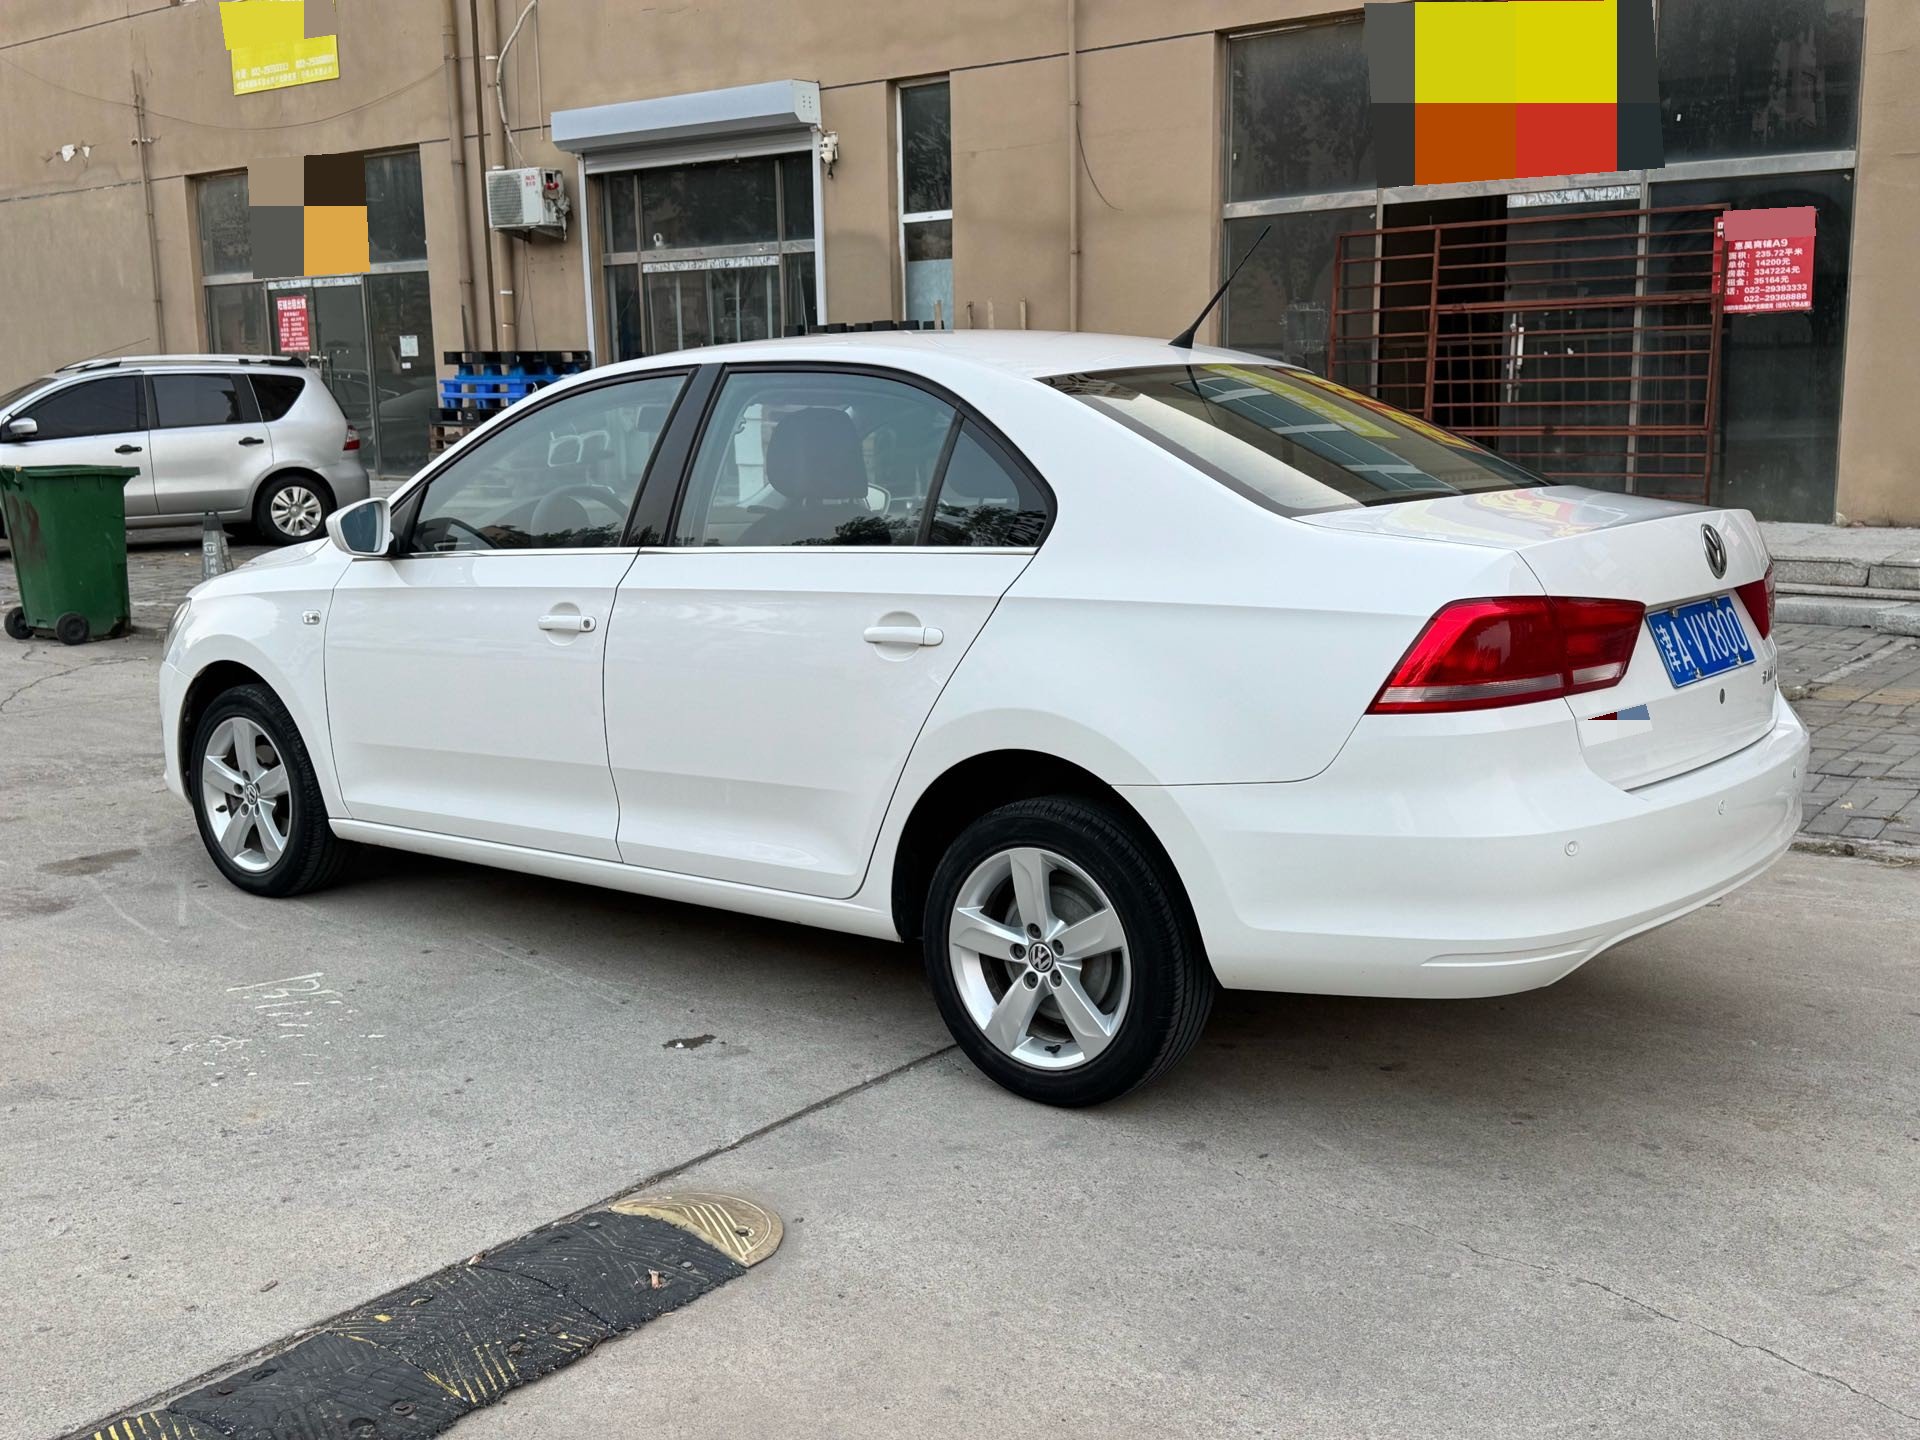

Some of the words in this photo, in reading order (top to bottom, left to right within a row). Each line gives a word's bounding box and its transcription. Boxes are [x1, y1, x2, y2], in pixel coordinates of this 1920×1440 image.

[1755, 248, 1803, 258] 235.72平米
[1755, 257, 1791, 266] 14200元
[1754, 266, 1801, 276] 3347224元
